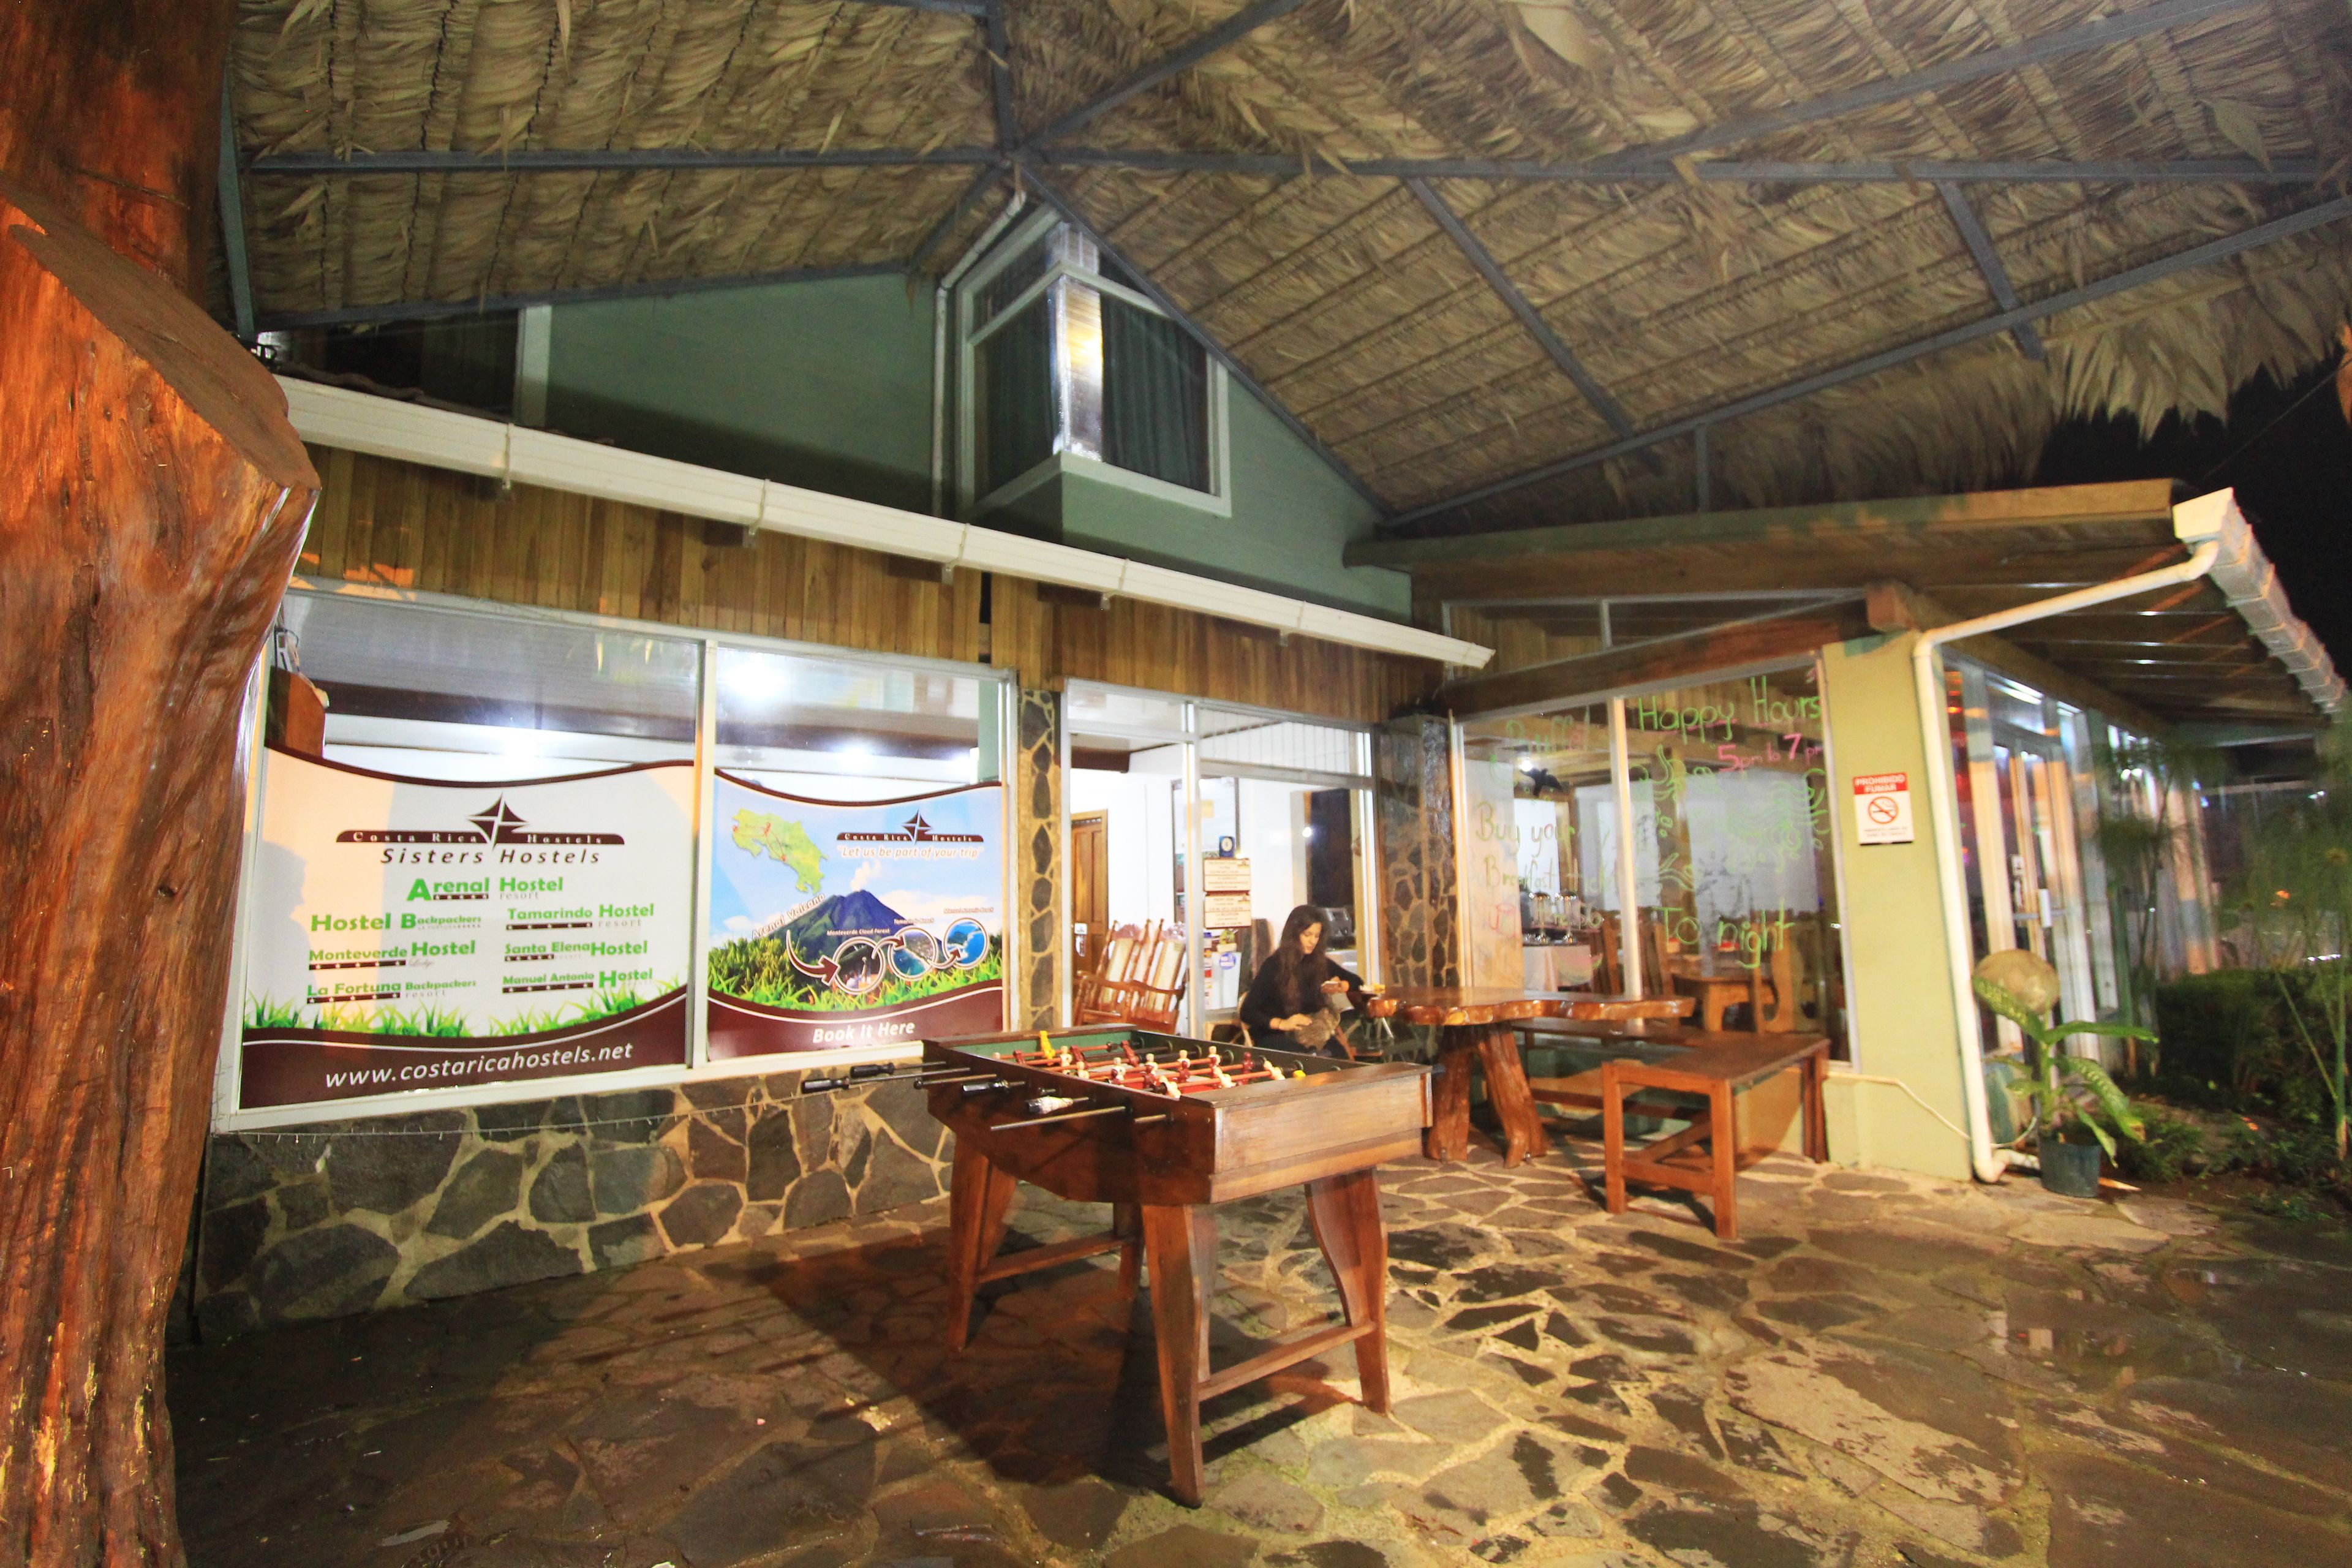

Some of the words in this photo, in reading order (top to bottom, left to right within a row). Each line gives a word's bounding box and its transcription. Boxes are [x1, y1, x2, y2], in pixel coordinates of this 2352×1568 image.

[1638, 696, 1735, 744] Happy
[1751, 676, 1822, 723] Hours
[353, 831, 415, 843] Costa
[431, 832, 478, 843] Rica
[527, 834, 603, 845] Hostels
[1476, 801, 1520, 856] Buy
[381, 848, 484, 864] Sisters
[500, 849, 600, 864] Hostels
[863, 848, 875, 857] us
[878, 846, 893, 857] be
[895, 847, 918, 859] part
[921, 846, 932, 859] of
[934, 849, 957, 859] your
[406, 876, 490, 901] Arenal
[499, 876, 564, 892] Hostel
[507, 907, 593, 920] Tamarindo
[598, 903, 654, 918] Hostel
[753, 915, 785, 938] Arenal
[787, 894, 825, 919] Volcano
[311, 912, 391, 932] Hostel
[401, 913, 482, 929] Backpackers
[309, 947, 407, 962] Monteverde
[411, 940, 476, 957] Hostel
[505, 943, 547, 954] Santa
[551, 941, 590, 952] Elena
[590, 940, 648, 956] Hostel
[502, 973, 546, 985] Manuel
[549, 971, 594, 982] Antonio
[598, 967, 653, 987] Hostel
[307, 984, 328, 997] La
[334, 981, 401, 995] Fortuna
[405, 980, 477, 991] Backpackers
[813, 1025, 854, 1044] Book
[860, 1023, 873, 1038] It
[878, 1022, 916, 1037] Here
[326, 1042, 633, 1088] www.costaricahostels.net
